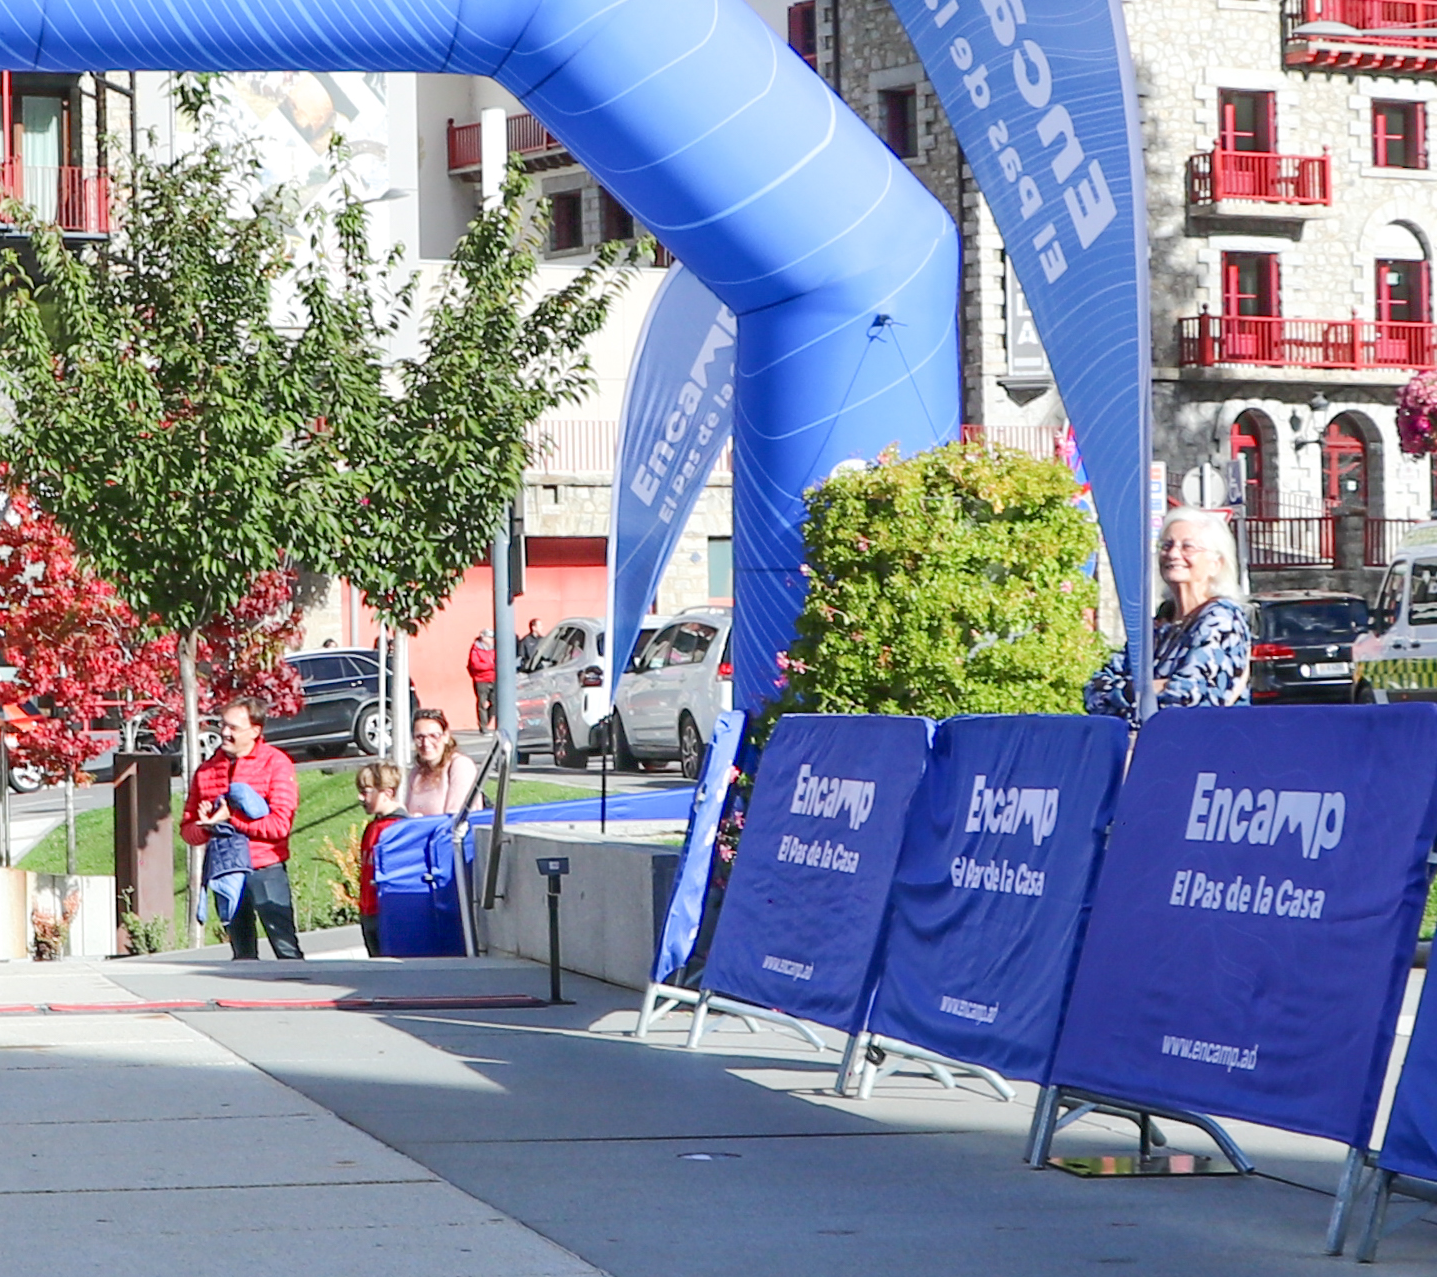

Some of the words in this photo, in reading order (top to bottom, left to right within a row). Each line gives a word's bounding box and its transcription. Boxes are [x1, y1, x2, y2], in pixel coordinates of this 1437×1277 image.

[658, 495, 678, 525] El
[672, 448, 701, 496] Pas
[697, 412, 721, 447] de
[713, 383, 734, 409] la
[790, 763, 876, 830] Encamp
[965, 775, 1059, 846] Encamp
[1185, 772, 1346, 860] Encamp
[777, 834, 792, 861] El
[787, 837, 809, 866] Pas
[807, 840, 822, 867] de
[821, 840, 832, 868] la
[831, 842, 860, 874] Casa
[1169, 869, 1192, 906] El
[1189, 872, 1224, 910] Pas
[1225, 875, 1251, 914] de
[1253, 875, 1274, 916] la
[1275, 878, 1326, 920] Casa
[1161, 1034, 1259, 1073] www.encamp.ad
